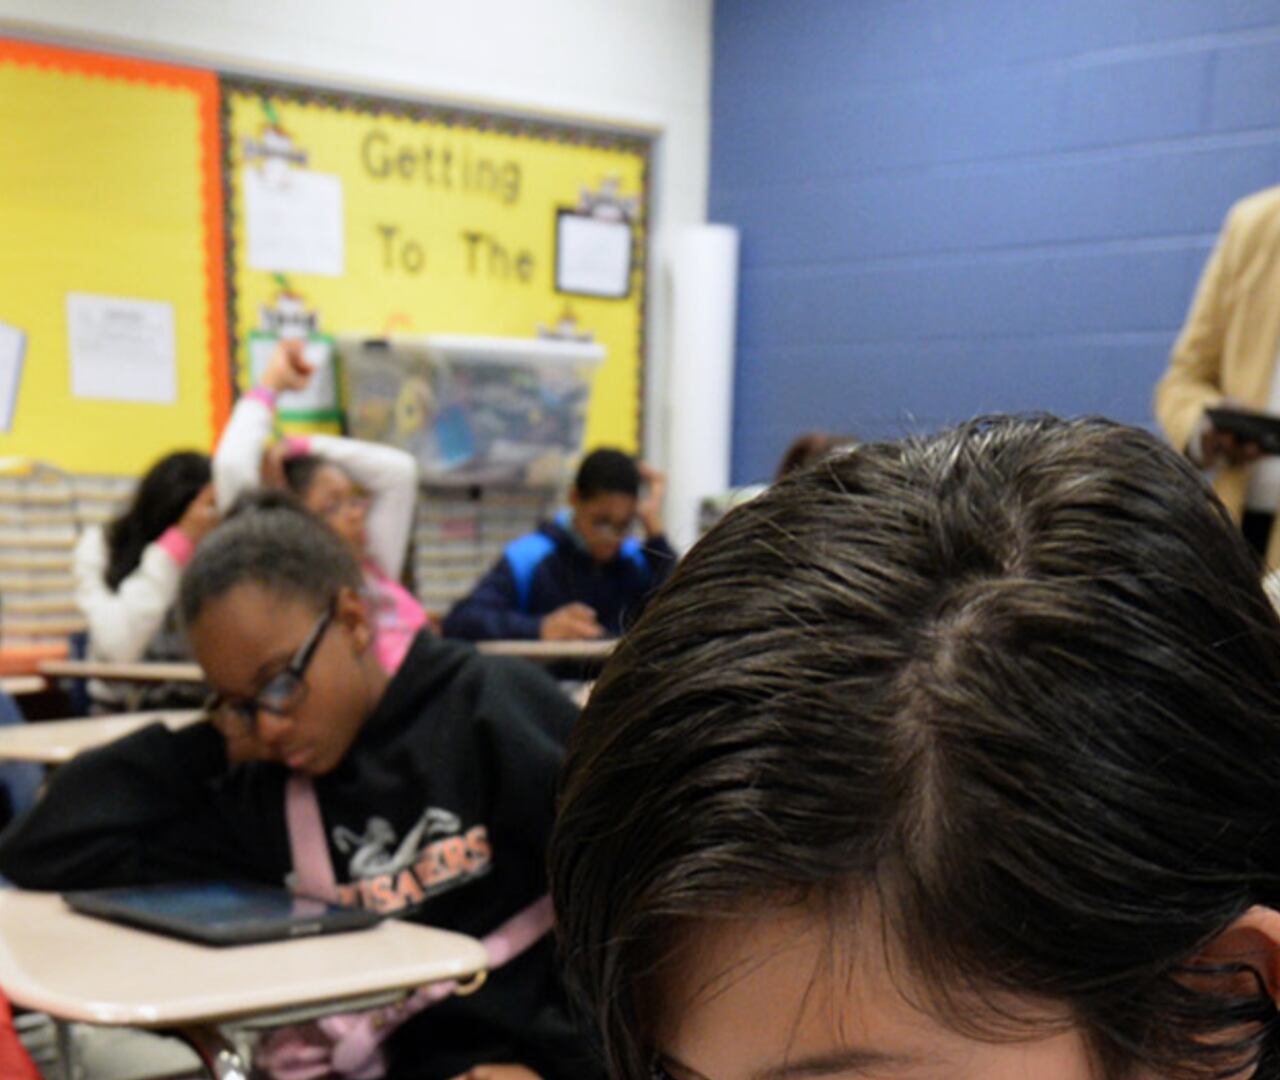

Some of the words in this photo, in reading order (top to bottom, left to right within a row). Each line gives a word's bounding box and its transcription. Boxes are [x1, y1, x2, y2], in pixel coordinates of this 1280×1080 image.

[361, 130, 521, 208] Getting
[377, 224, 426, 274] To
[462, 230, 535, 284] The
